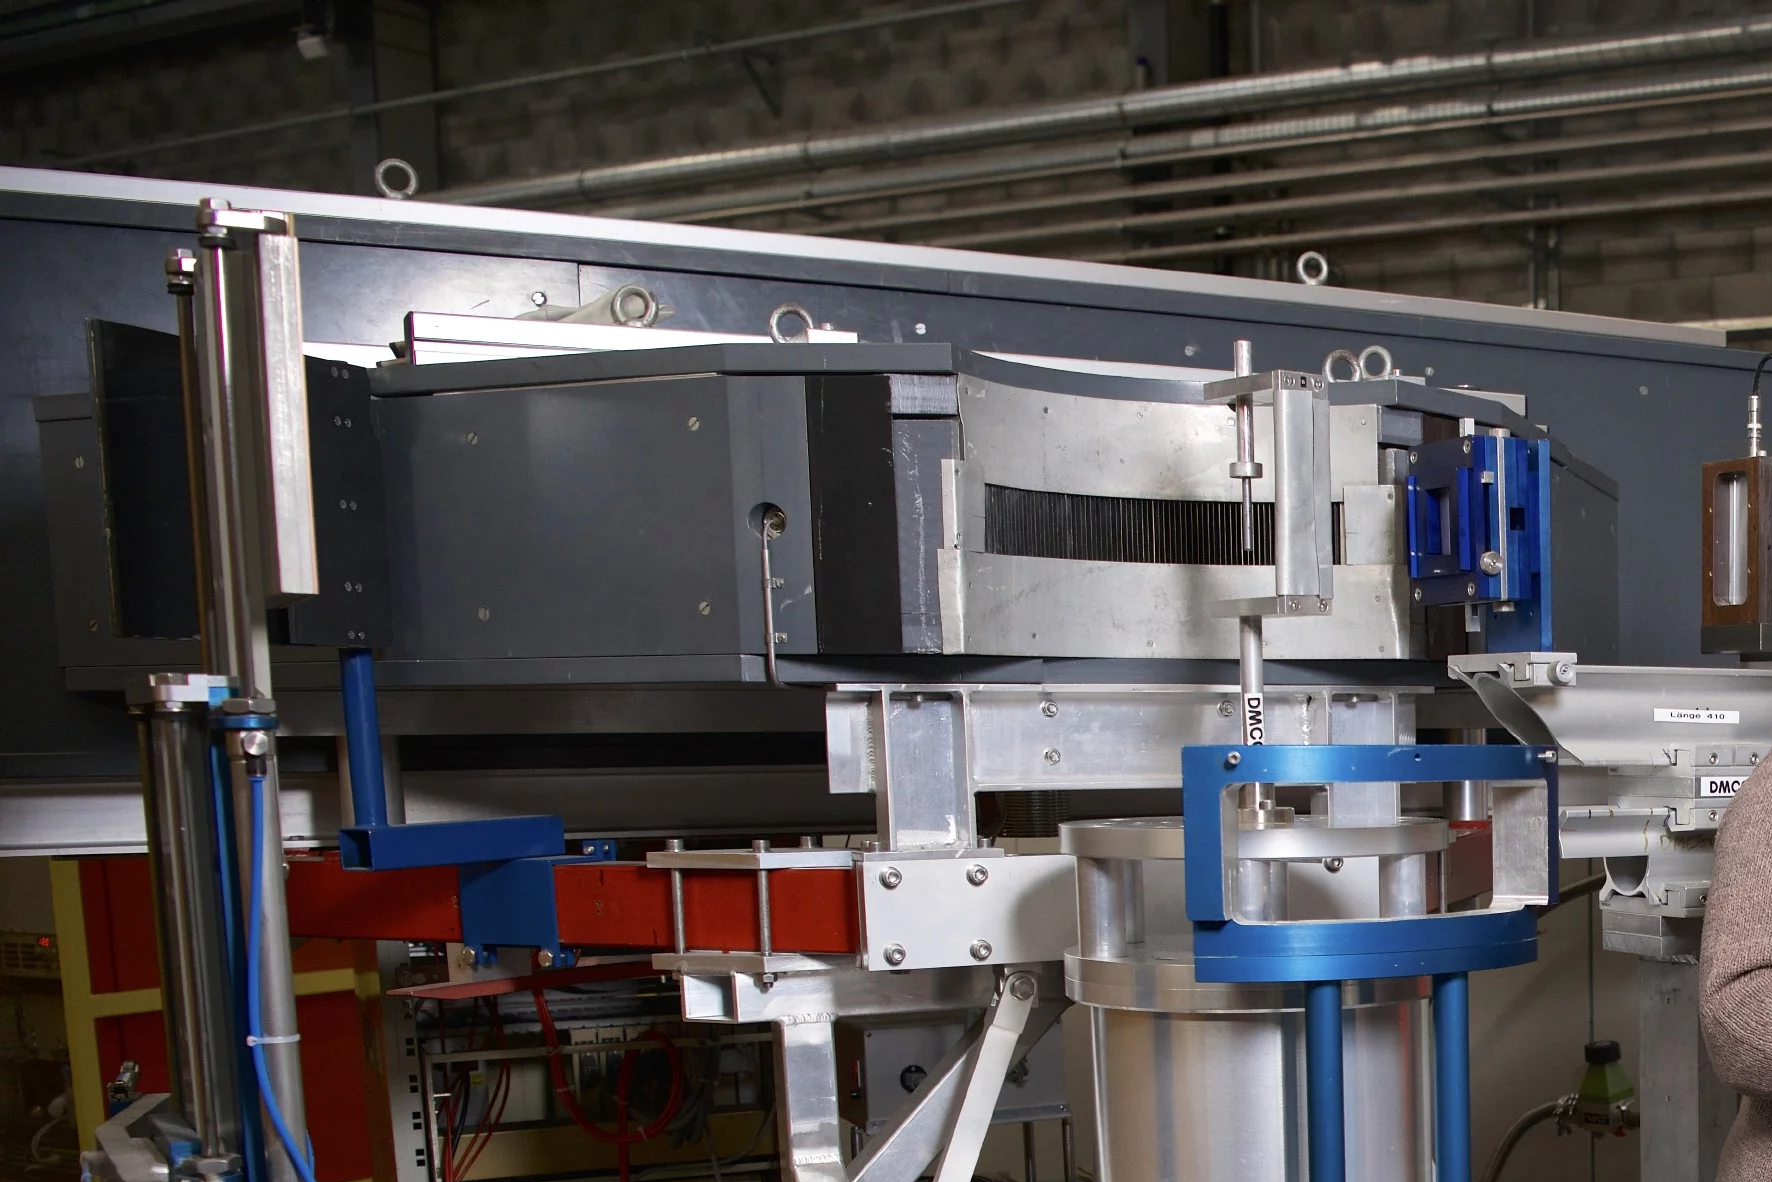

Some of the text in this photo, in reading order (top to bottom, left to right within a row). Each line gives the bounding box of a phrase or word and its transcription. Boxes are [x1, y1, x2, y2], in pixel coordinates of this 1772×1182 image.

[1247, 697, 1263, 745] DMC
[1670, 711, 1701, 720] Länge
[1709, 780, 1745, 794] DMC
